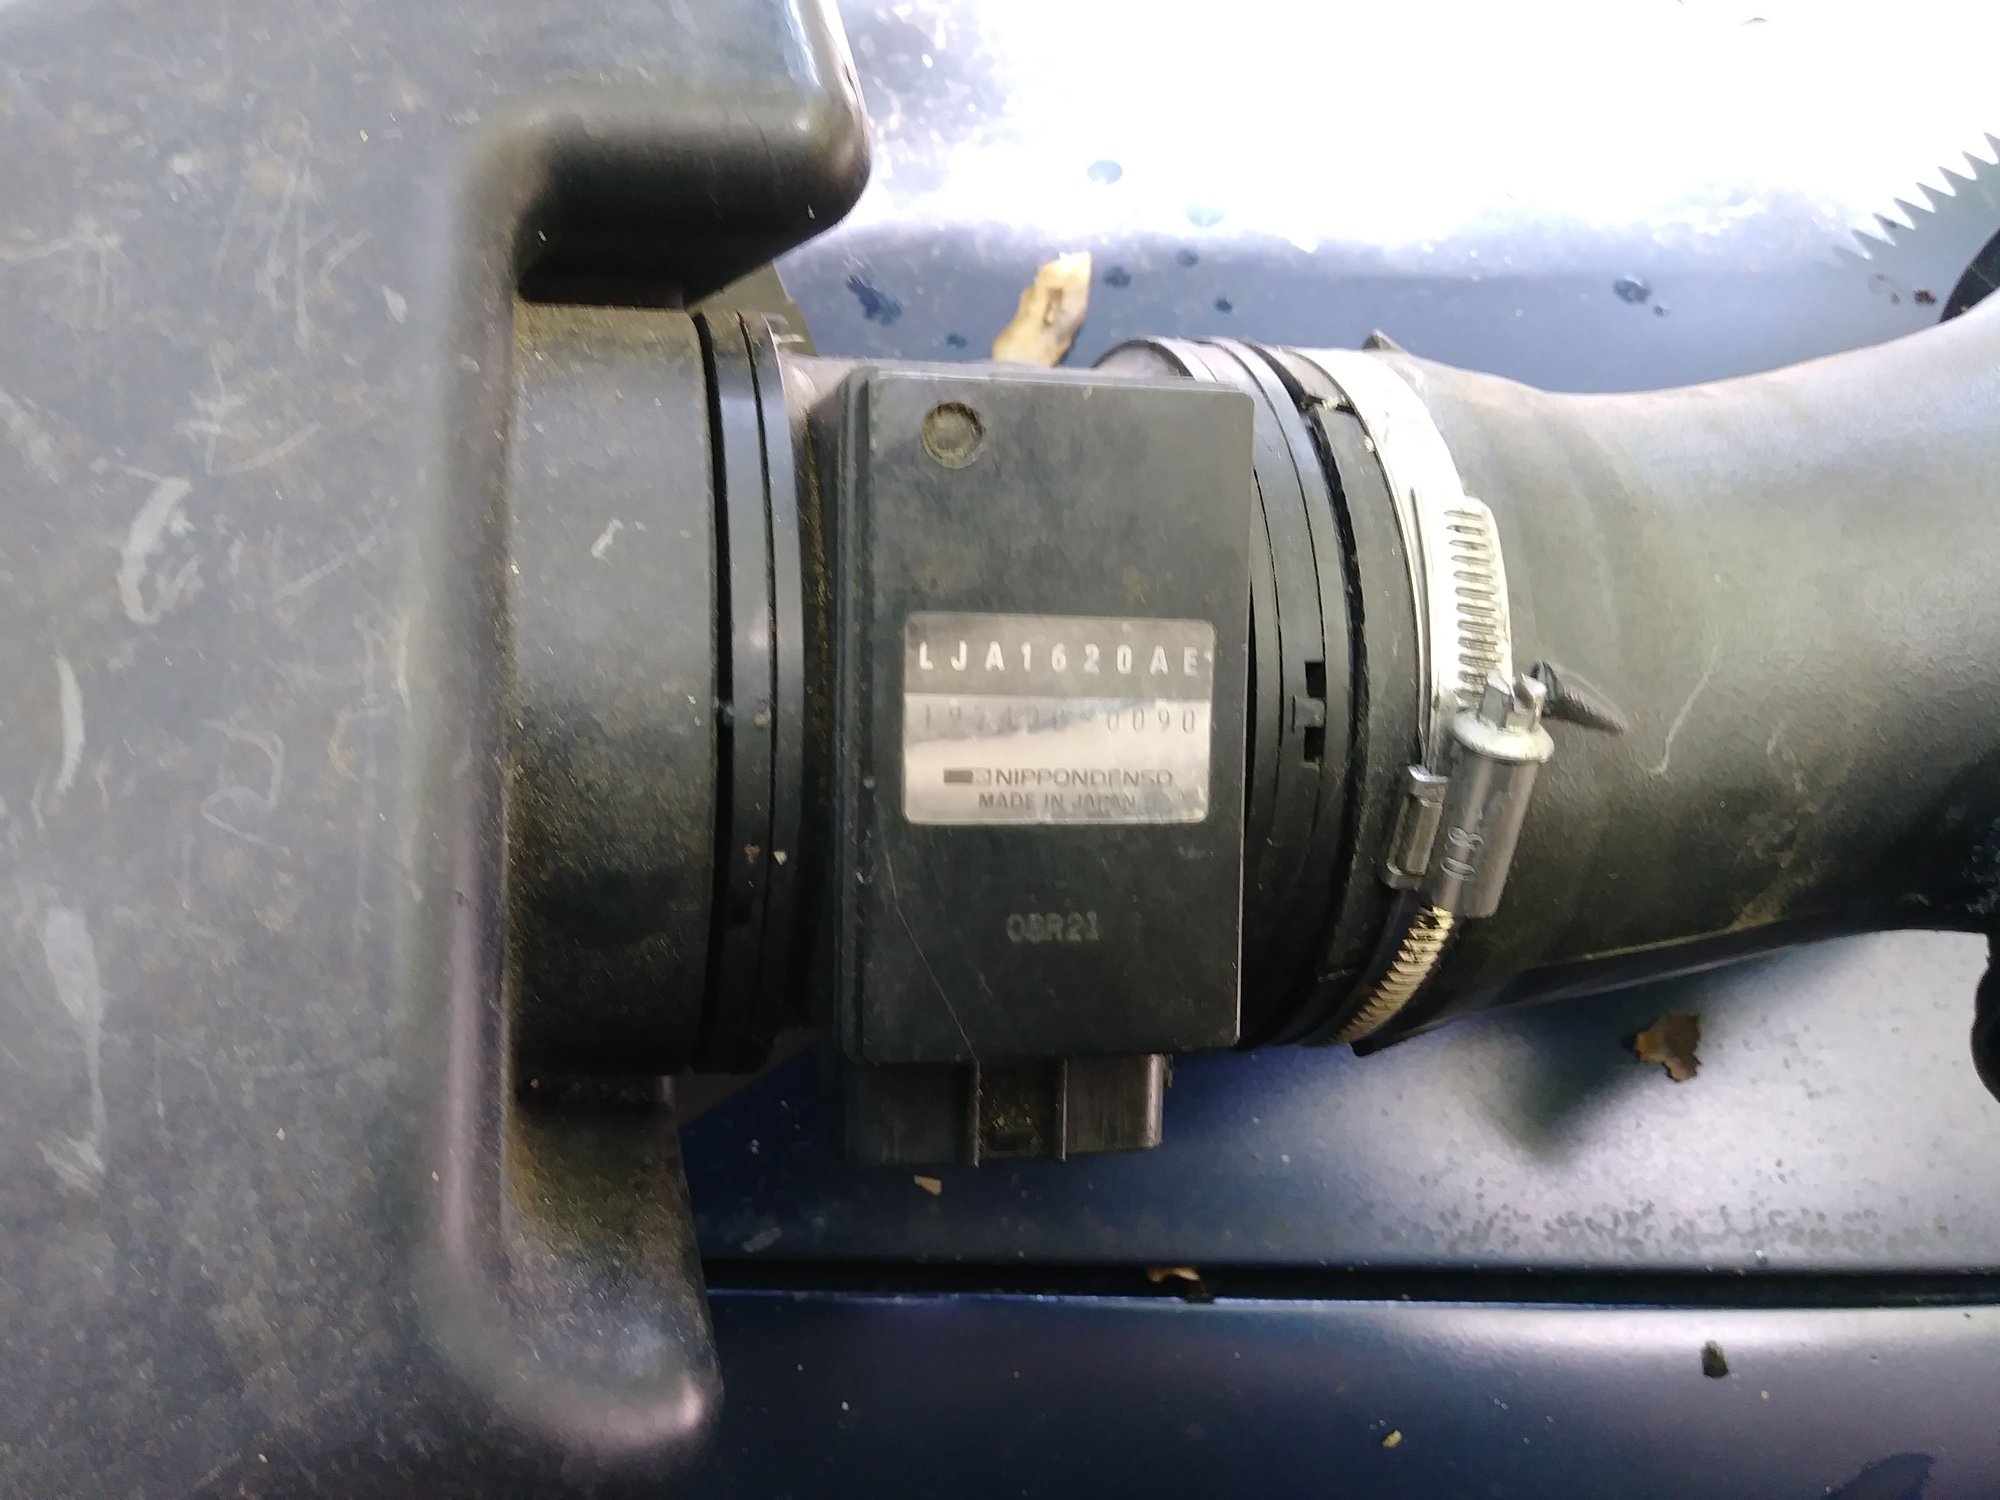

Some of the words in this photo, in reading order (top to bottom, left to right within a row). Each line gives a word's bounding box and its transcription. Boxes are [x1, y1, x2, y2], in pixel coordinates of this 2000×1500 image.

[918, 640, 1199, 676] LJA1620AE
[995, 768, 1174, 788] NIPPONDENSO
[978, 791, 1034, 810] MADE
[1044, 791, 1064, 809] IN
[1071, 791, 1136, 811] JAPAN
